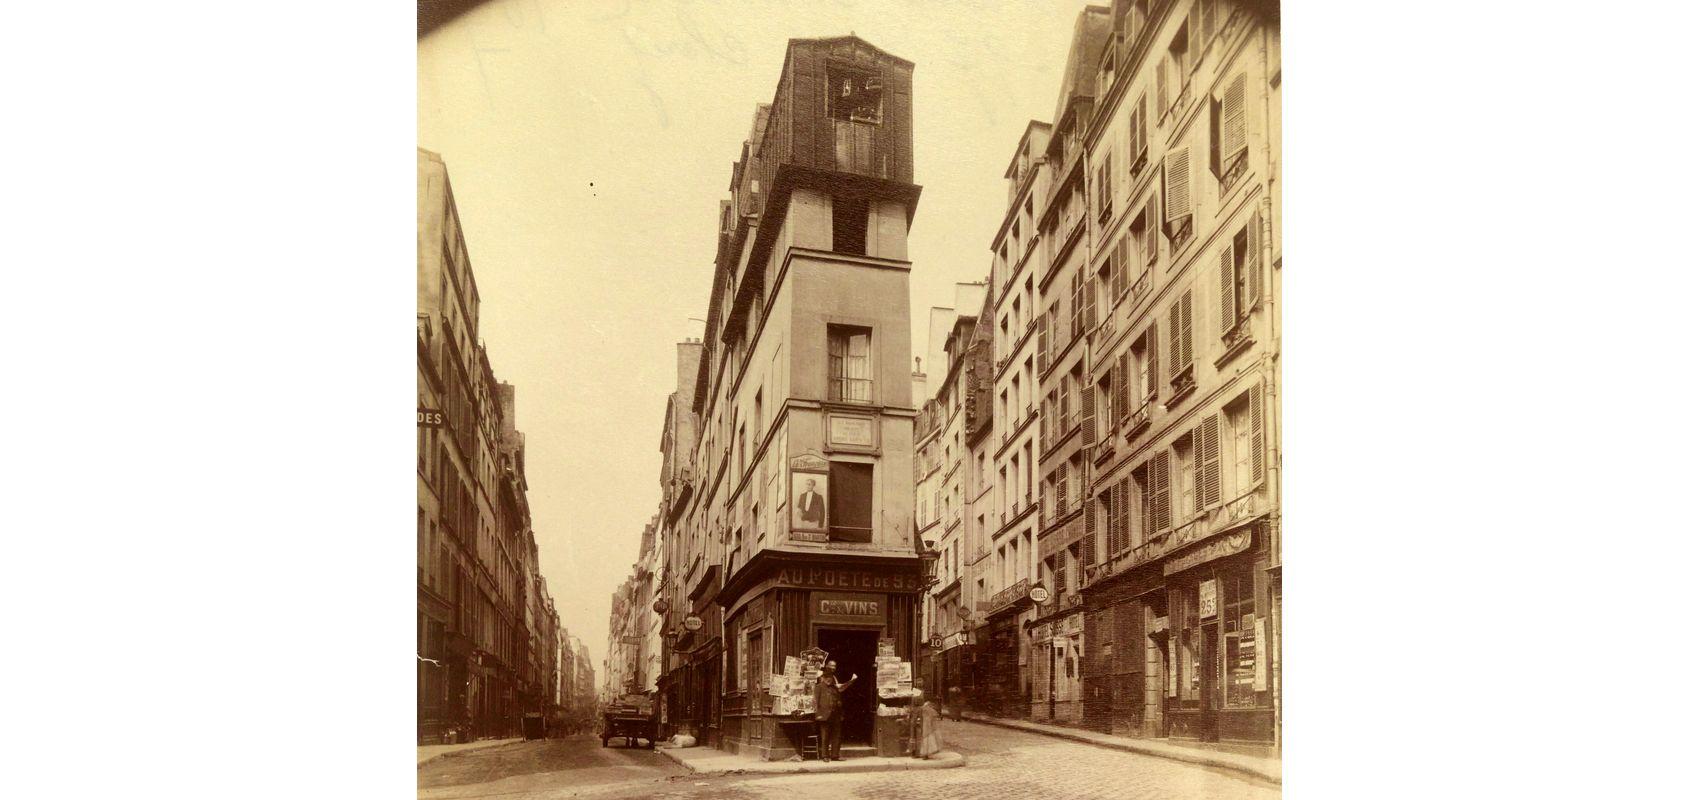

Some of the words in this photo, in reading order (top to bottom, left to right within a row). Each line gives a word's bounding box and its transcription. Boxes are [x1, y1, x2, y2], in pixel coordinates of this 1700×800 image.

[417, 412, 442, 424] DES
[777, 569, 803, 584] AU
[845, 601, 878, 615] VINS
[929, 638, 942, 648] 10
